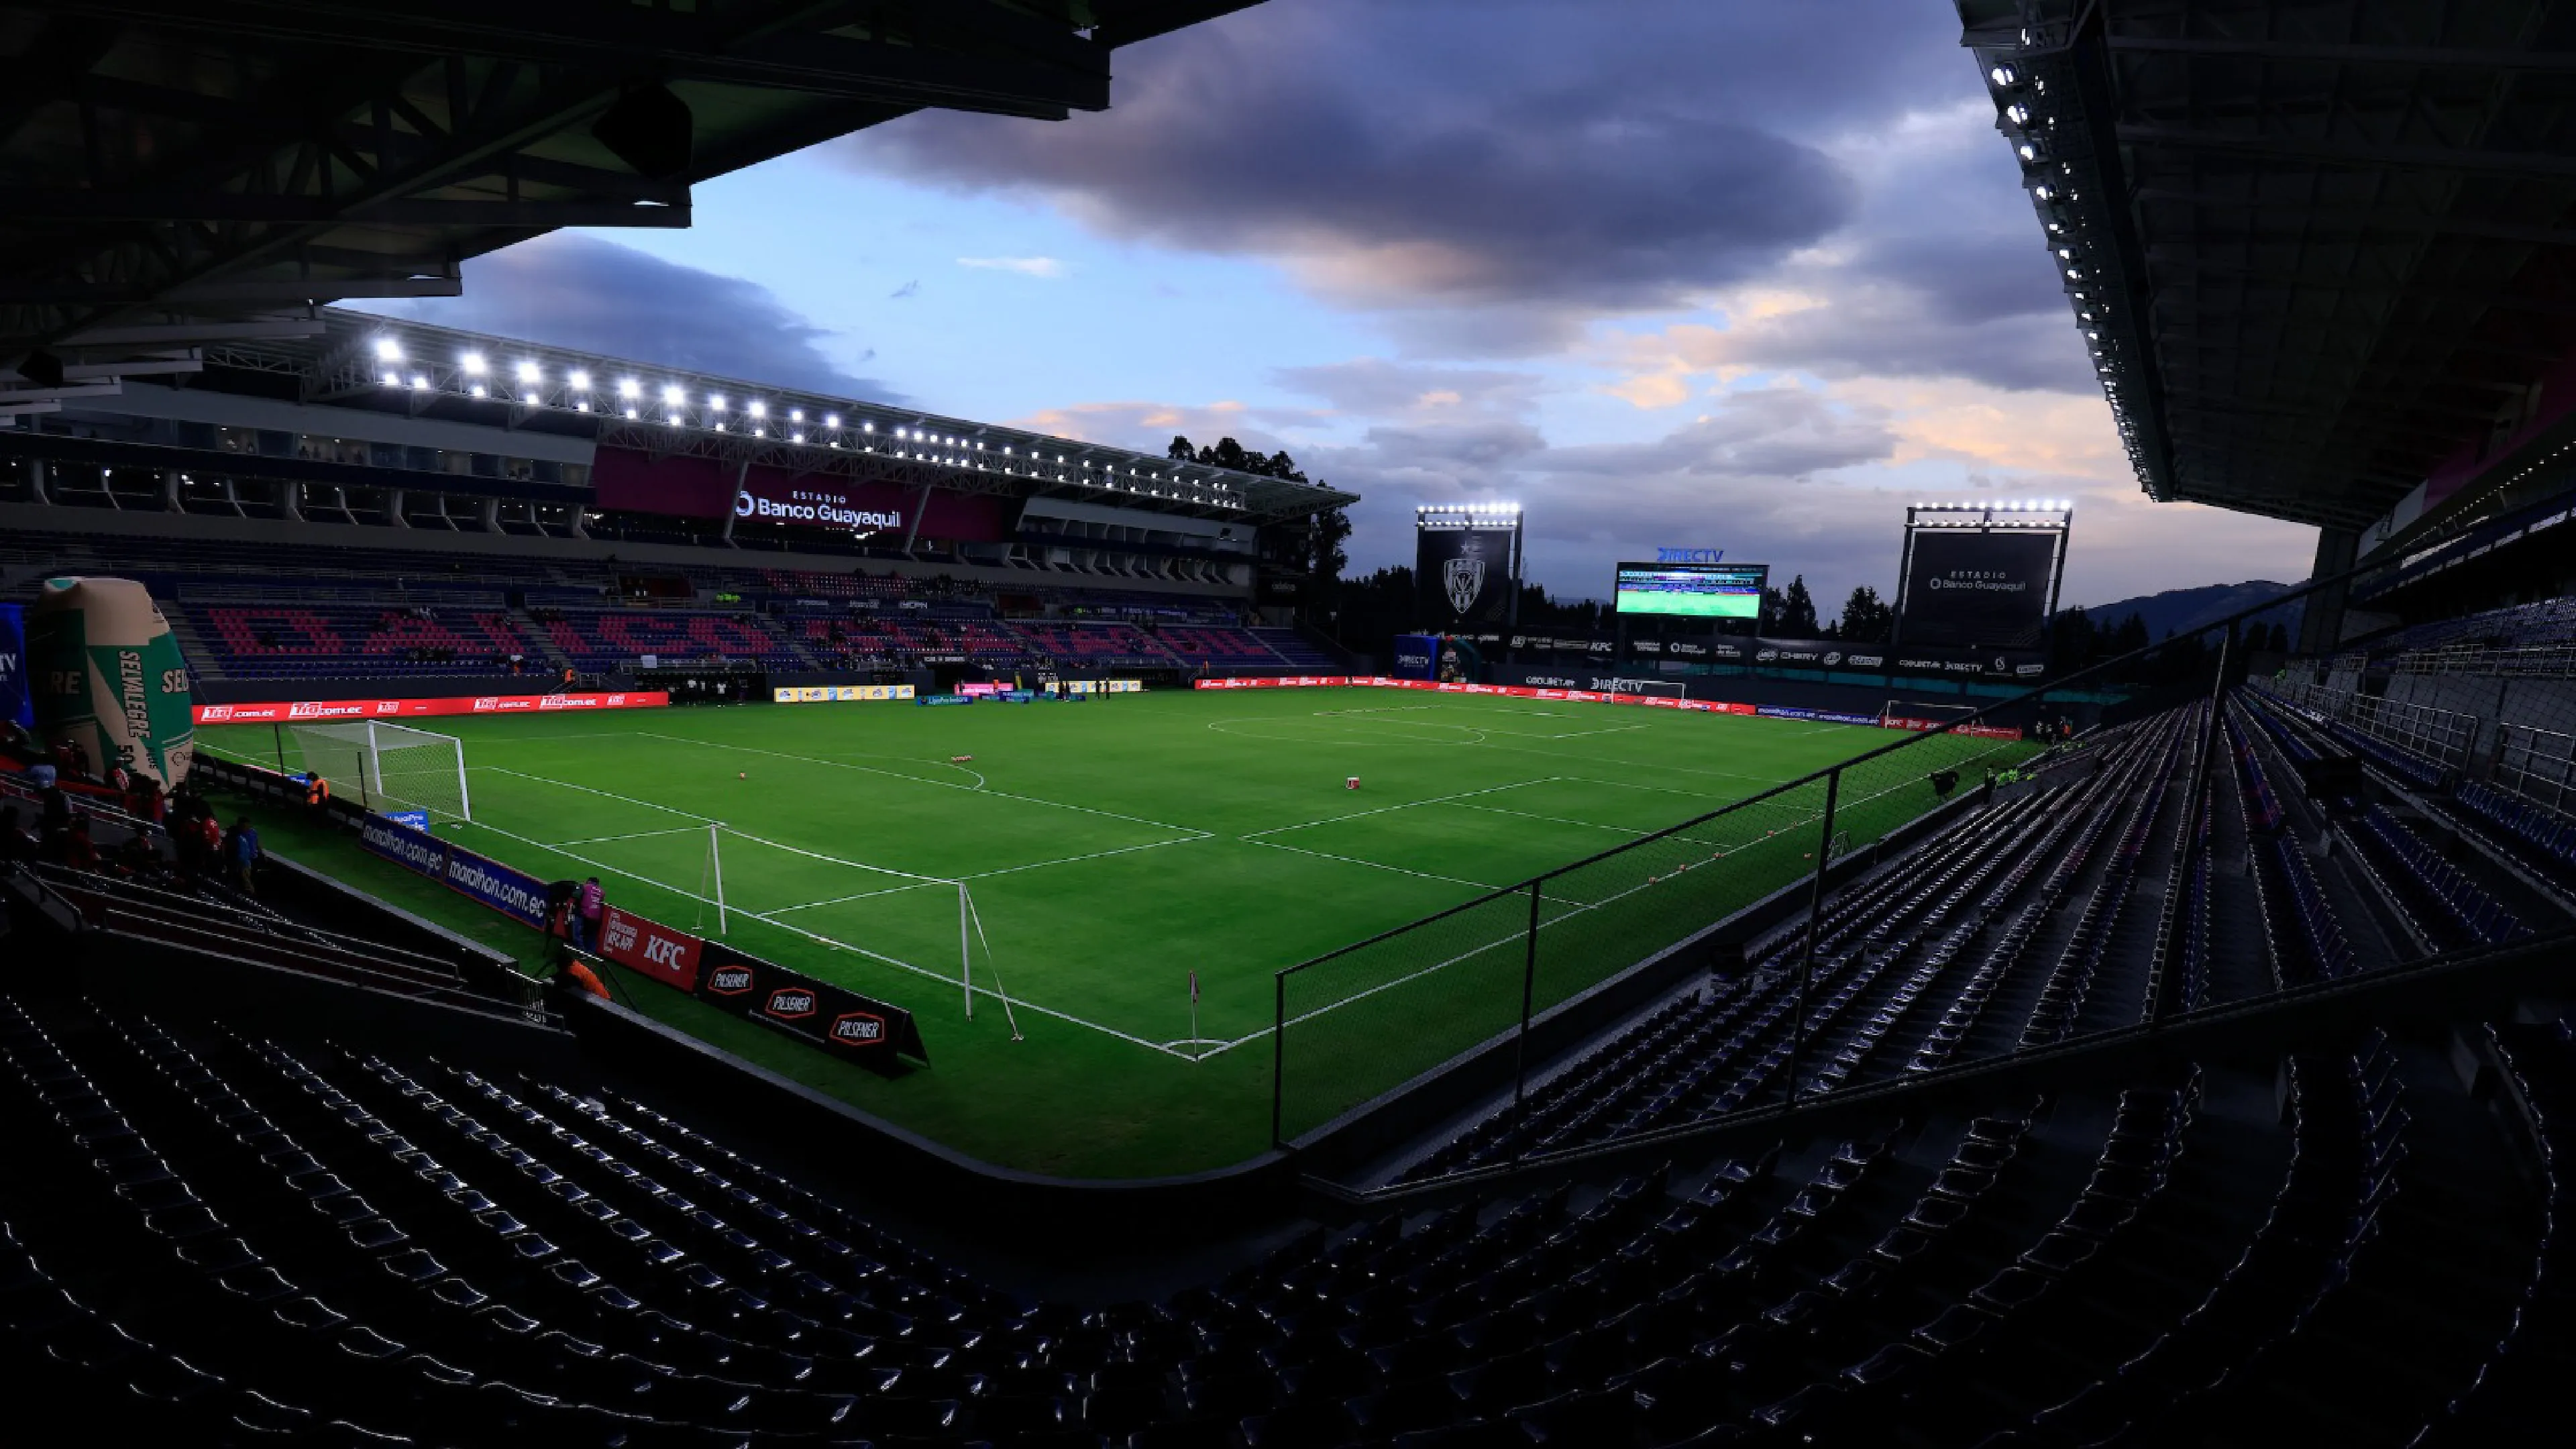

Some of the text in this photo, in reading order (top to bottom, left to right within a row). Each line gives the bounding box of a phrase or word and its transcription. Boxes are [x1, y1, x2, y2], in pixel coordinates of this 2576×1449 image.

[793, 490, 846, 504] ESTADIO
[757, 498, 901, 530] Banco Guayaquil
[1657, 547, 1724, 563] DIRECTV
[1951, 571, 2006, 579] ESTADIO
[1943, 579, 2026, 592] Banco Guayaquil
[1591, 677, 1644, 693] DIRECTV
[119, 650, 151, 739] SELVALEGRE
[449, 861, 546, 918] marathon.com.ec
[644, 934, 685, 970] KFC
[714, 973, 749, 987] PILSENER
[772, 996, 810, 1012] PILSENER
[837, 1020, 879, 1038] PILSENER
